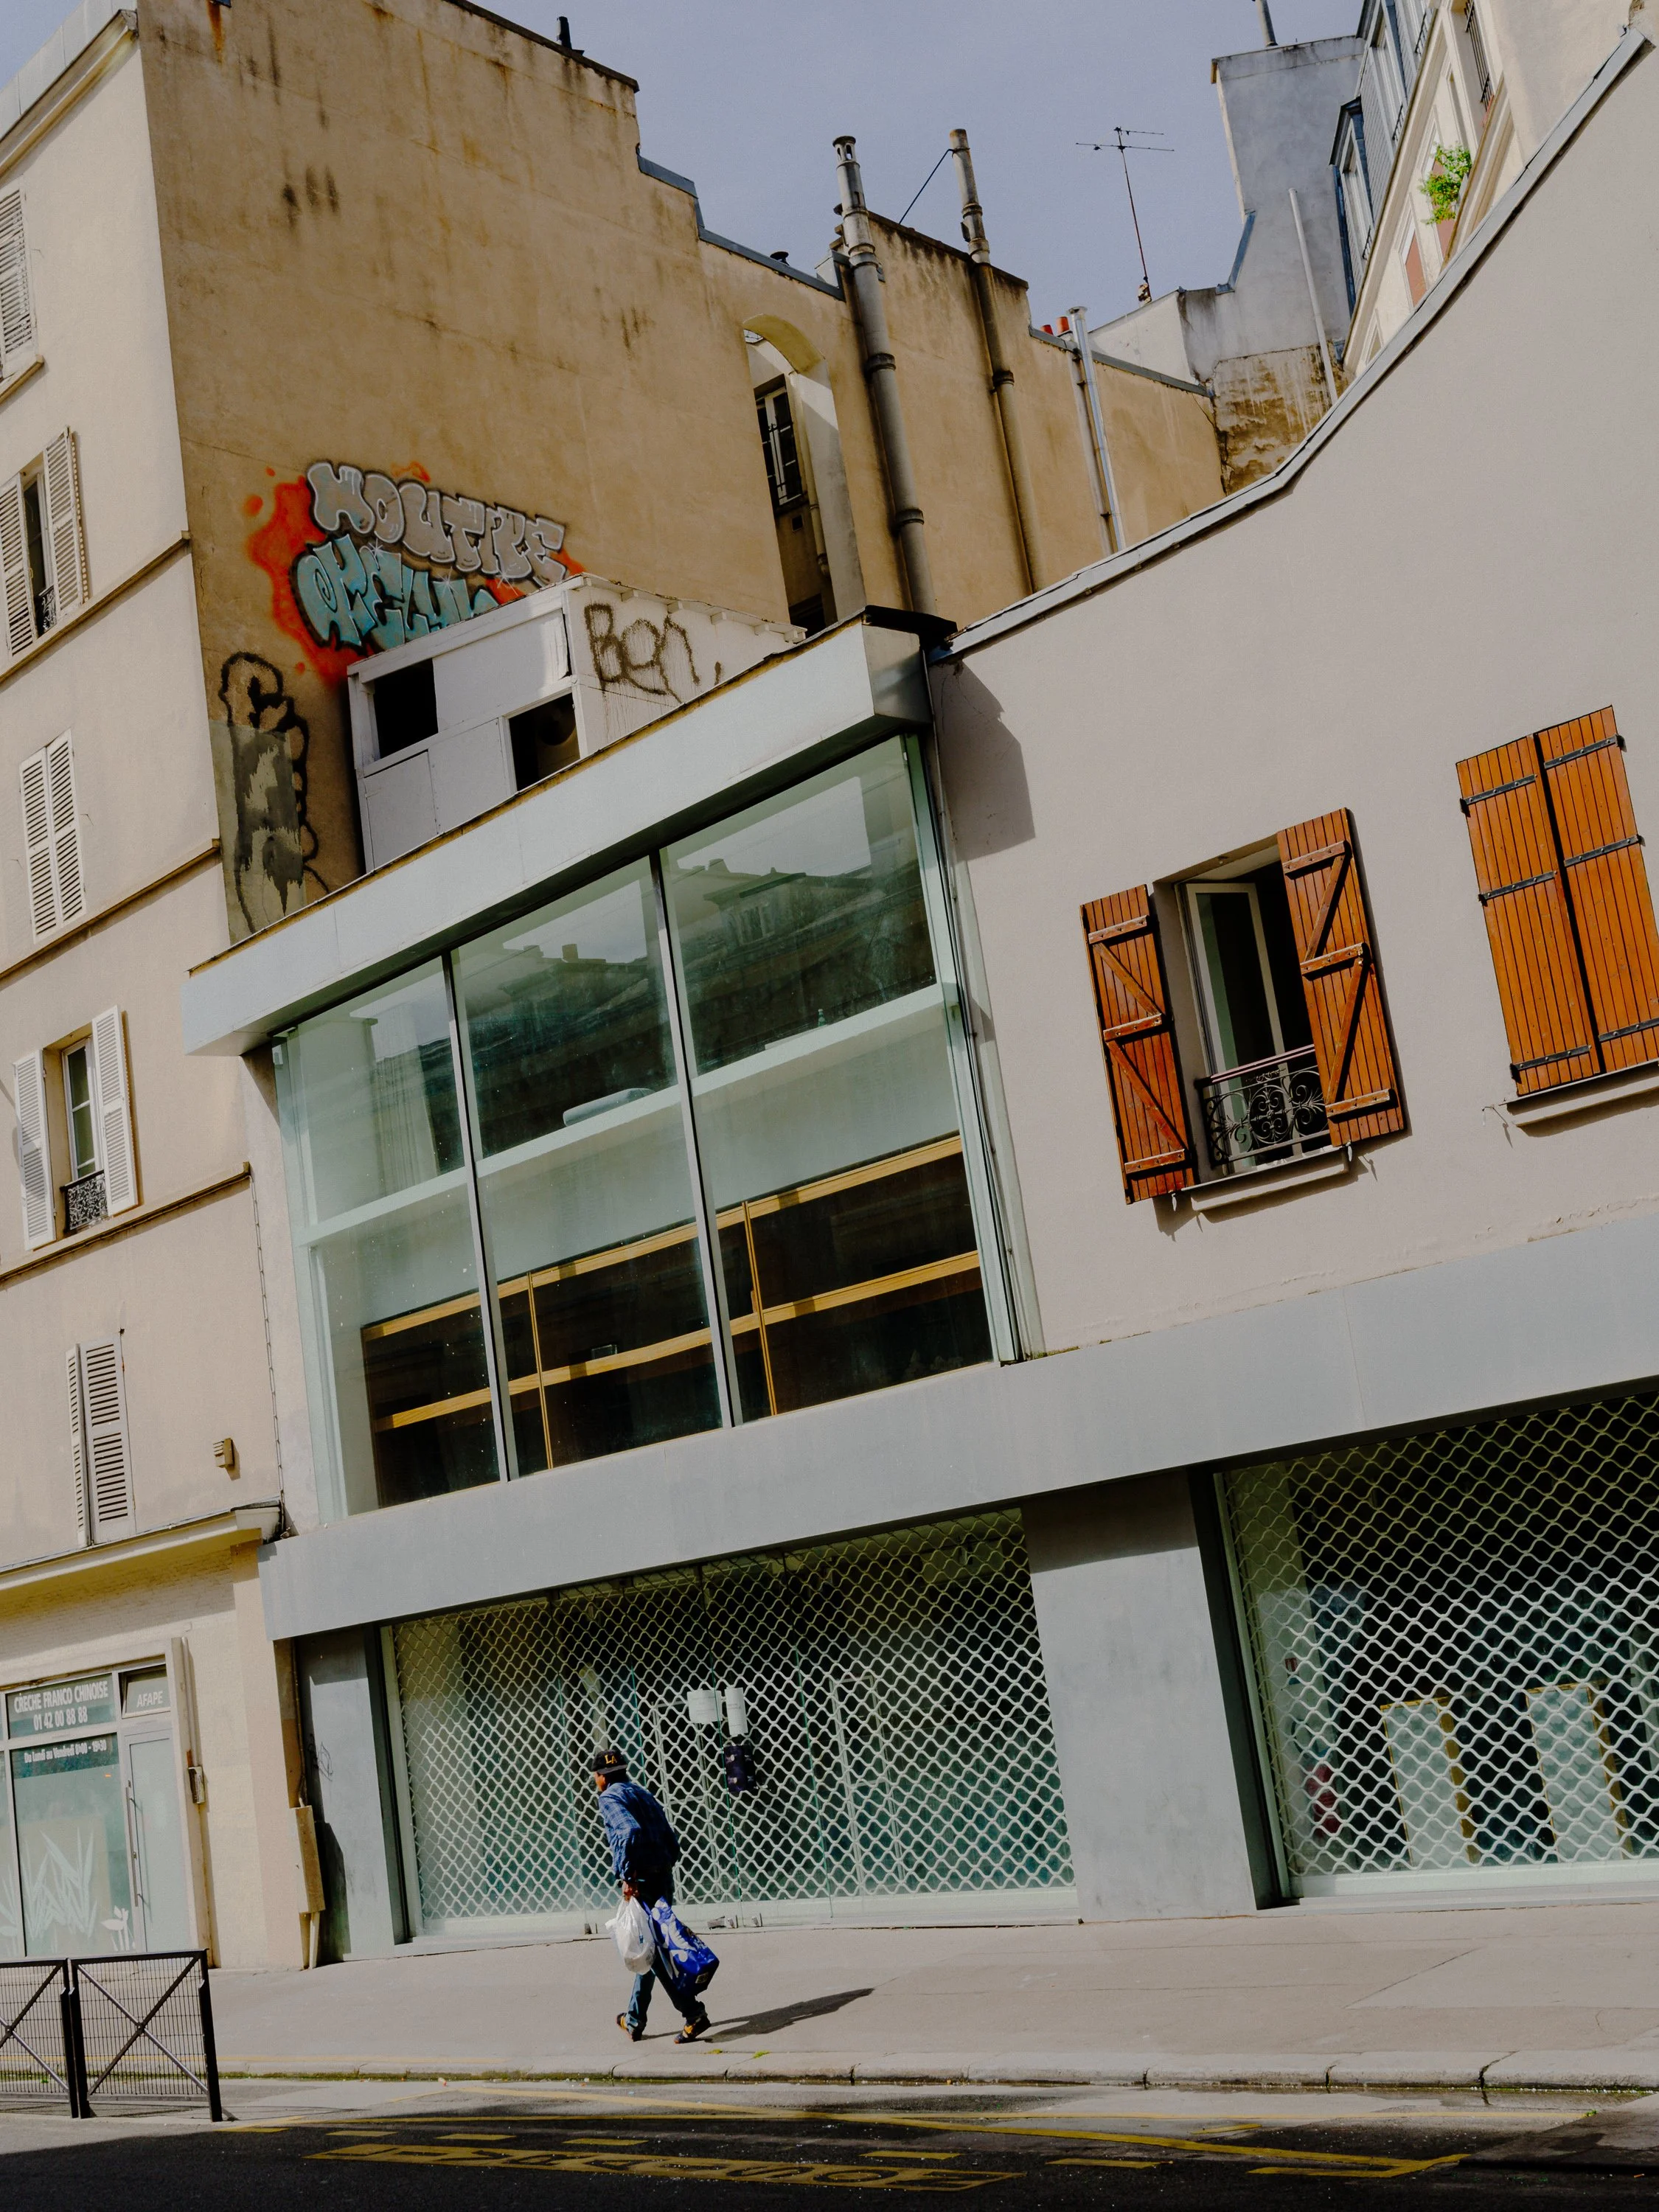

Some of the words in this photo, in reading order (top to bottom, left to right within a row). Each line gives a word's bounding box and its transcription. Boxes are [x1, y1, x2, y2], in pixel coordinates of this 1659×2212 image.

[43, 1687, 73, 1708] FRANCO
[74, 1680, 108, 1703] CHINOISE
[136, 1690, 163, 1708] AFAPE
[33, 1714, 42, 1731] 01
[44, 1711, 54, 1729] 42
[55, 1709, 64, 1727] 00
[66, 1708, 77, 1725] 88
[77, 1705, 88, 1724] 88
[53, 1744, 75, 1759] Vendredi
[605, 1754, 617, 1764] LA
[320, 2146, 1007, 2188] LIVRAISON
